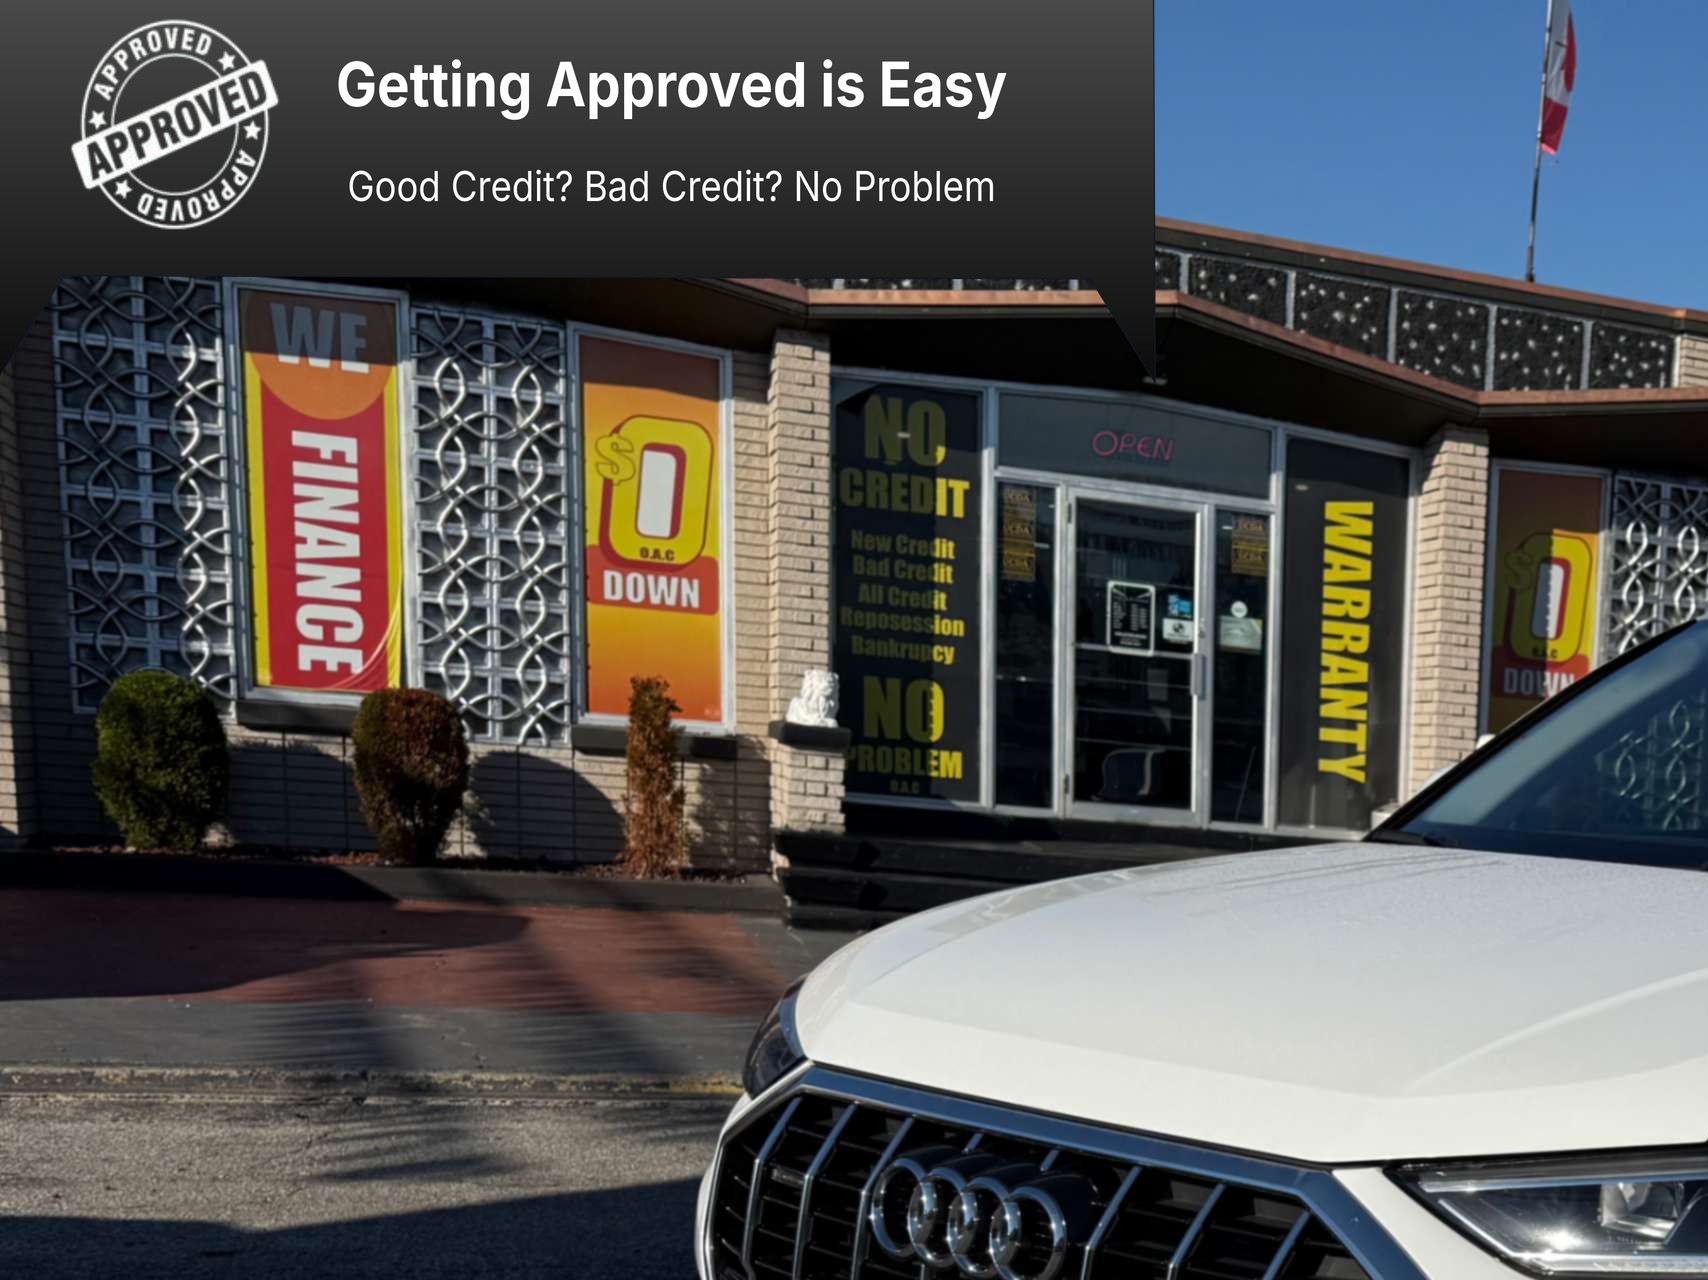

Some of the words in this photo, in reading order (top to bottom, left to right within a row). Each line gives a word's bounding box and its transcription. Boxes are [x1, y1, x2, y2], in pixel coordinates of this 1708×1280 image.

[270, 302, 370, 374] WE
[864, 394, 946, 466] NO
[1092, 431, 1173, 461] OPEN
[839, 467, 970, 518] CREDIT
[291, 430, 364, 674] FINANCE
[852, 530, 892, 553] New
[895, 534, 955, 560] Credit
[853, 555, 890, 577] Bad
[894, 560, 953, 584] Credit
[603, 570, 700, 608] DOWN
[888, 590, 948, 611] Credit
[1318, 502, 1373, 784] WARRANTY
[863, 675, 945, 743] NO
